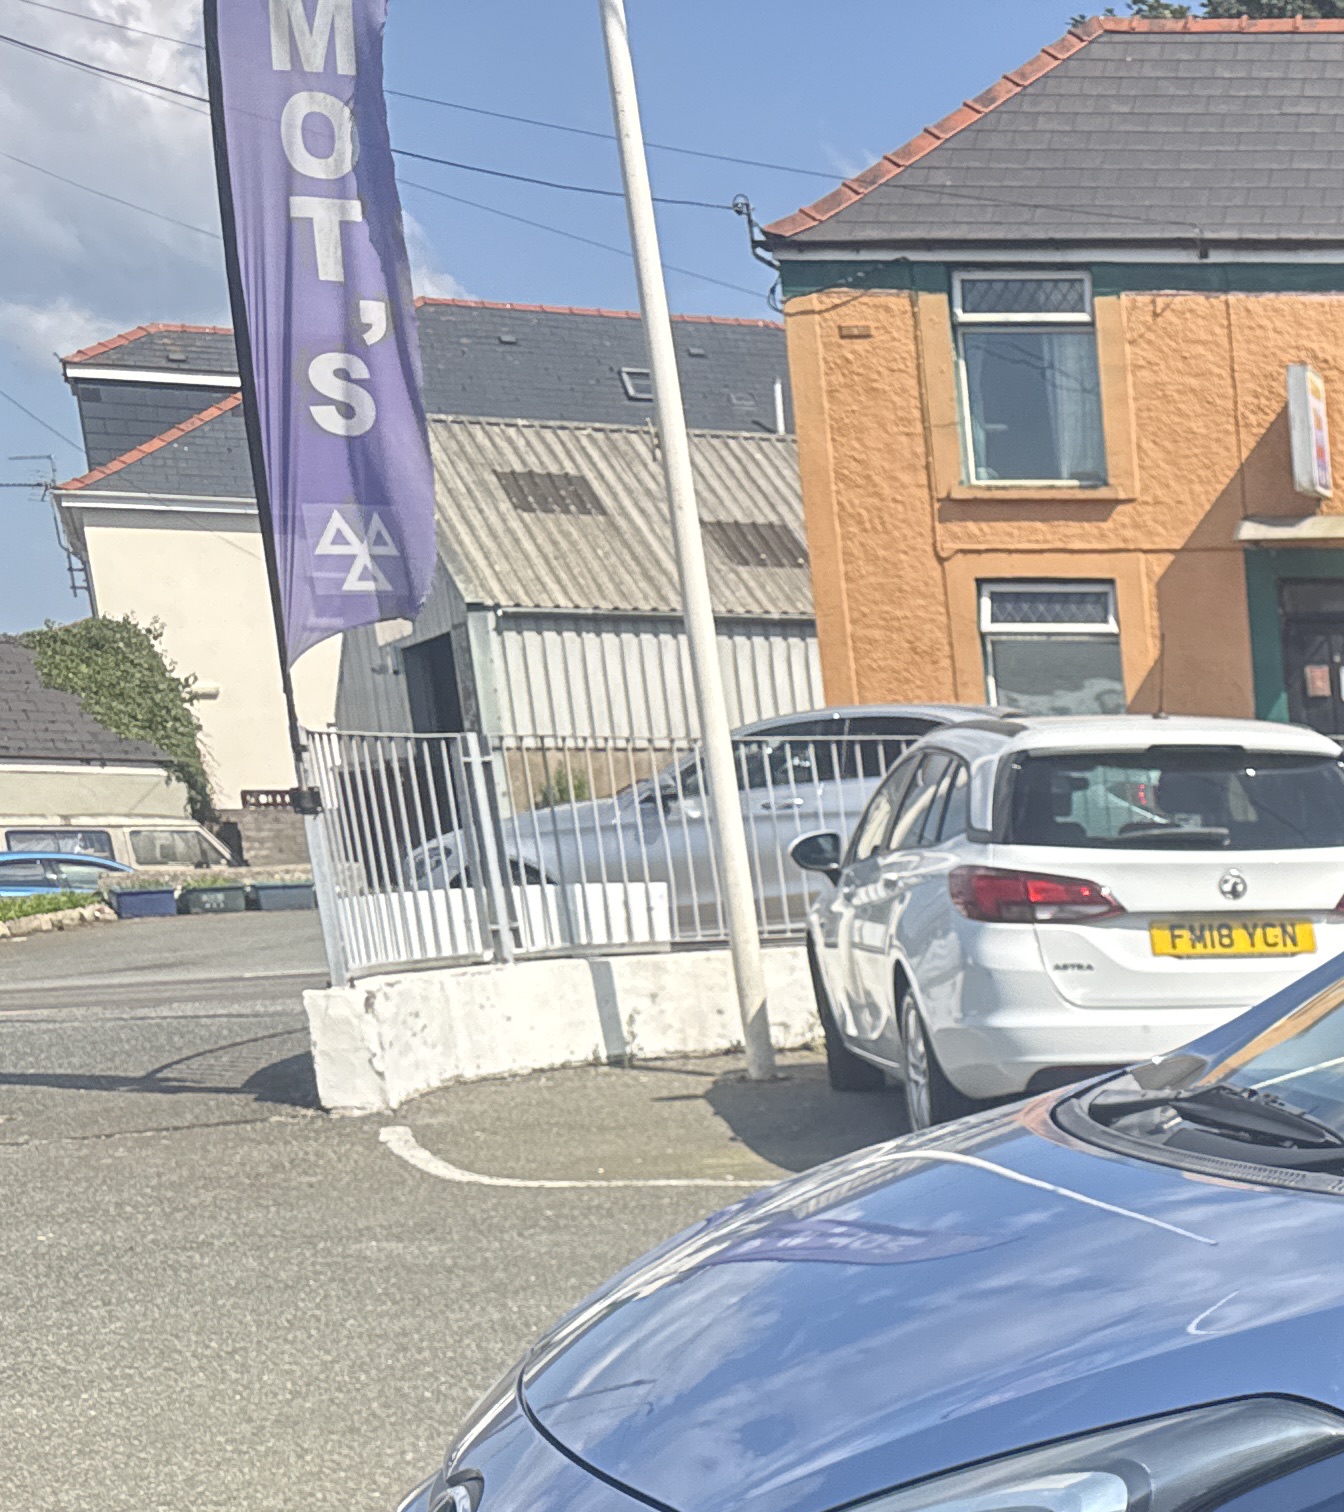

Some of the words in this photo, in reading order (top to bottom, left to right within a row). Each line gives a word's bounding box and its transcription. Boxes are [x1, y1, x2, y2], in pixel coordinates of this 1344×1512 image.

[269, 0, 388, 437] MOT'S
[1169, 923, 1235, 951] FM18
[1244, 922, 1299, 949] YCN
